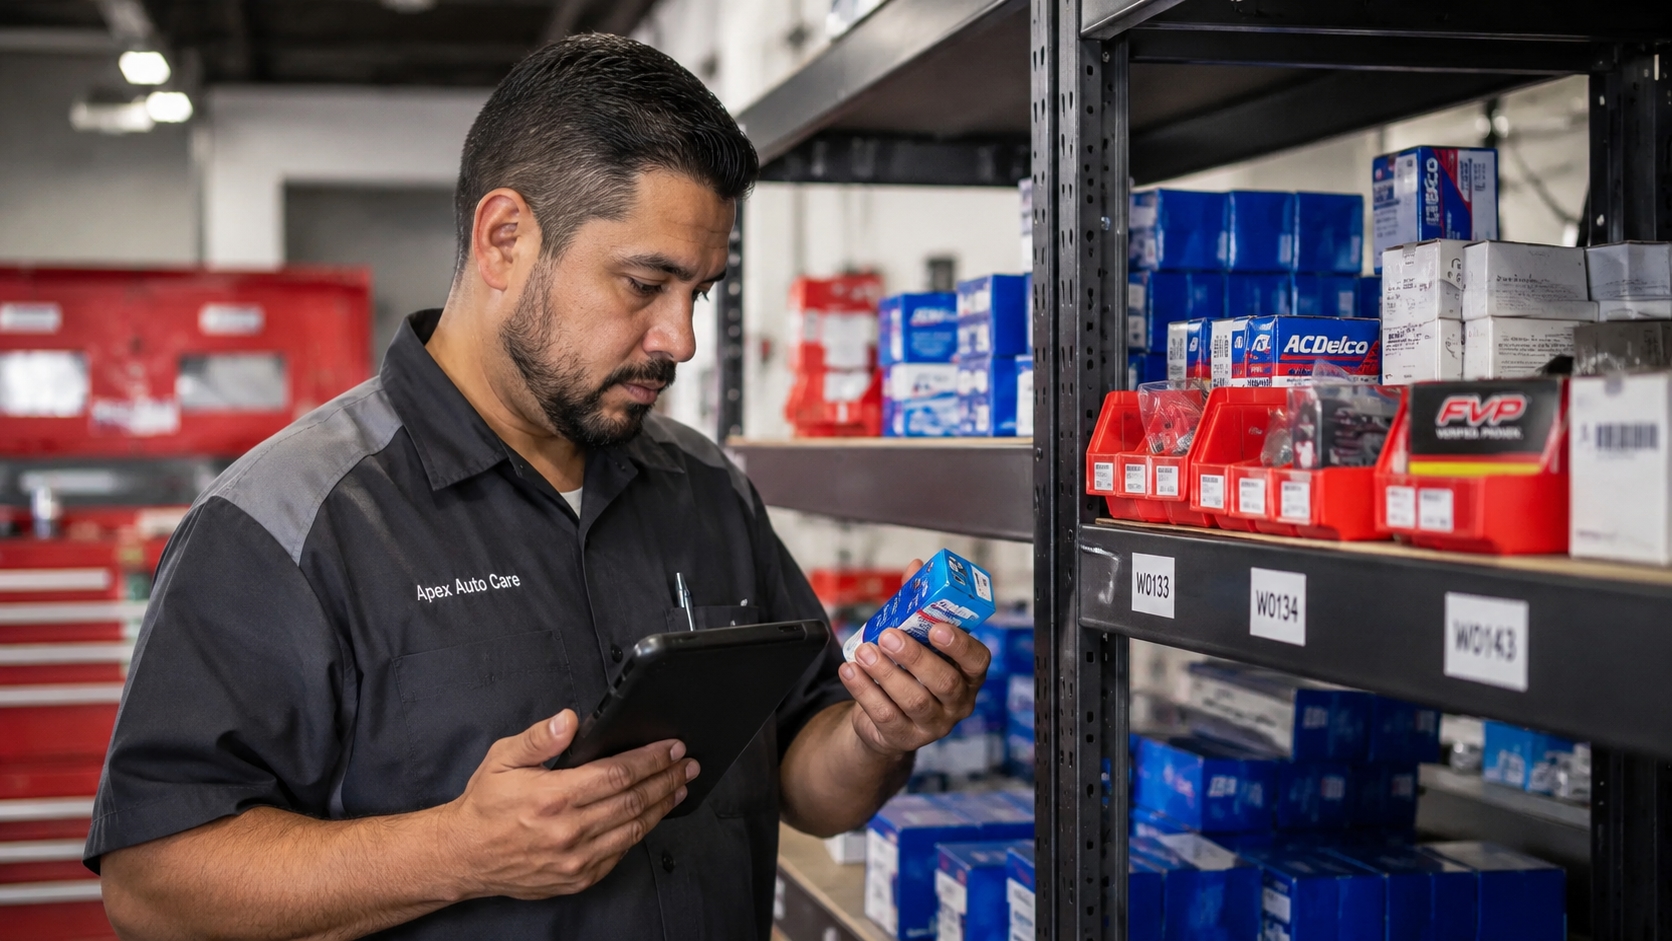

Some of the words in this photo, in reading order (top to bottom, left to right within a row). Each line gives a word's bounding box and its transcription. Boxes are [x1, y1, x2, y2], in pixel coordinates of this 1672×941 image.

[1283, 334, 1369, 354] ACDelco
[1435, 394, 1527, 427] FVP
[416, 584, 453, 603] Apex
[455, 577, 488, 595] Auto
[488, 573, 521, 589] Care
[1136, 571, 1170, 599] W0133
[1256, 589, 1299, 624] W0134
